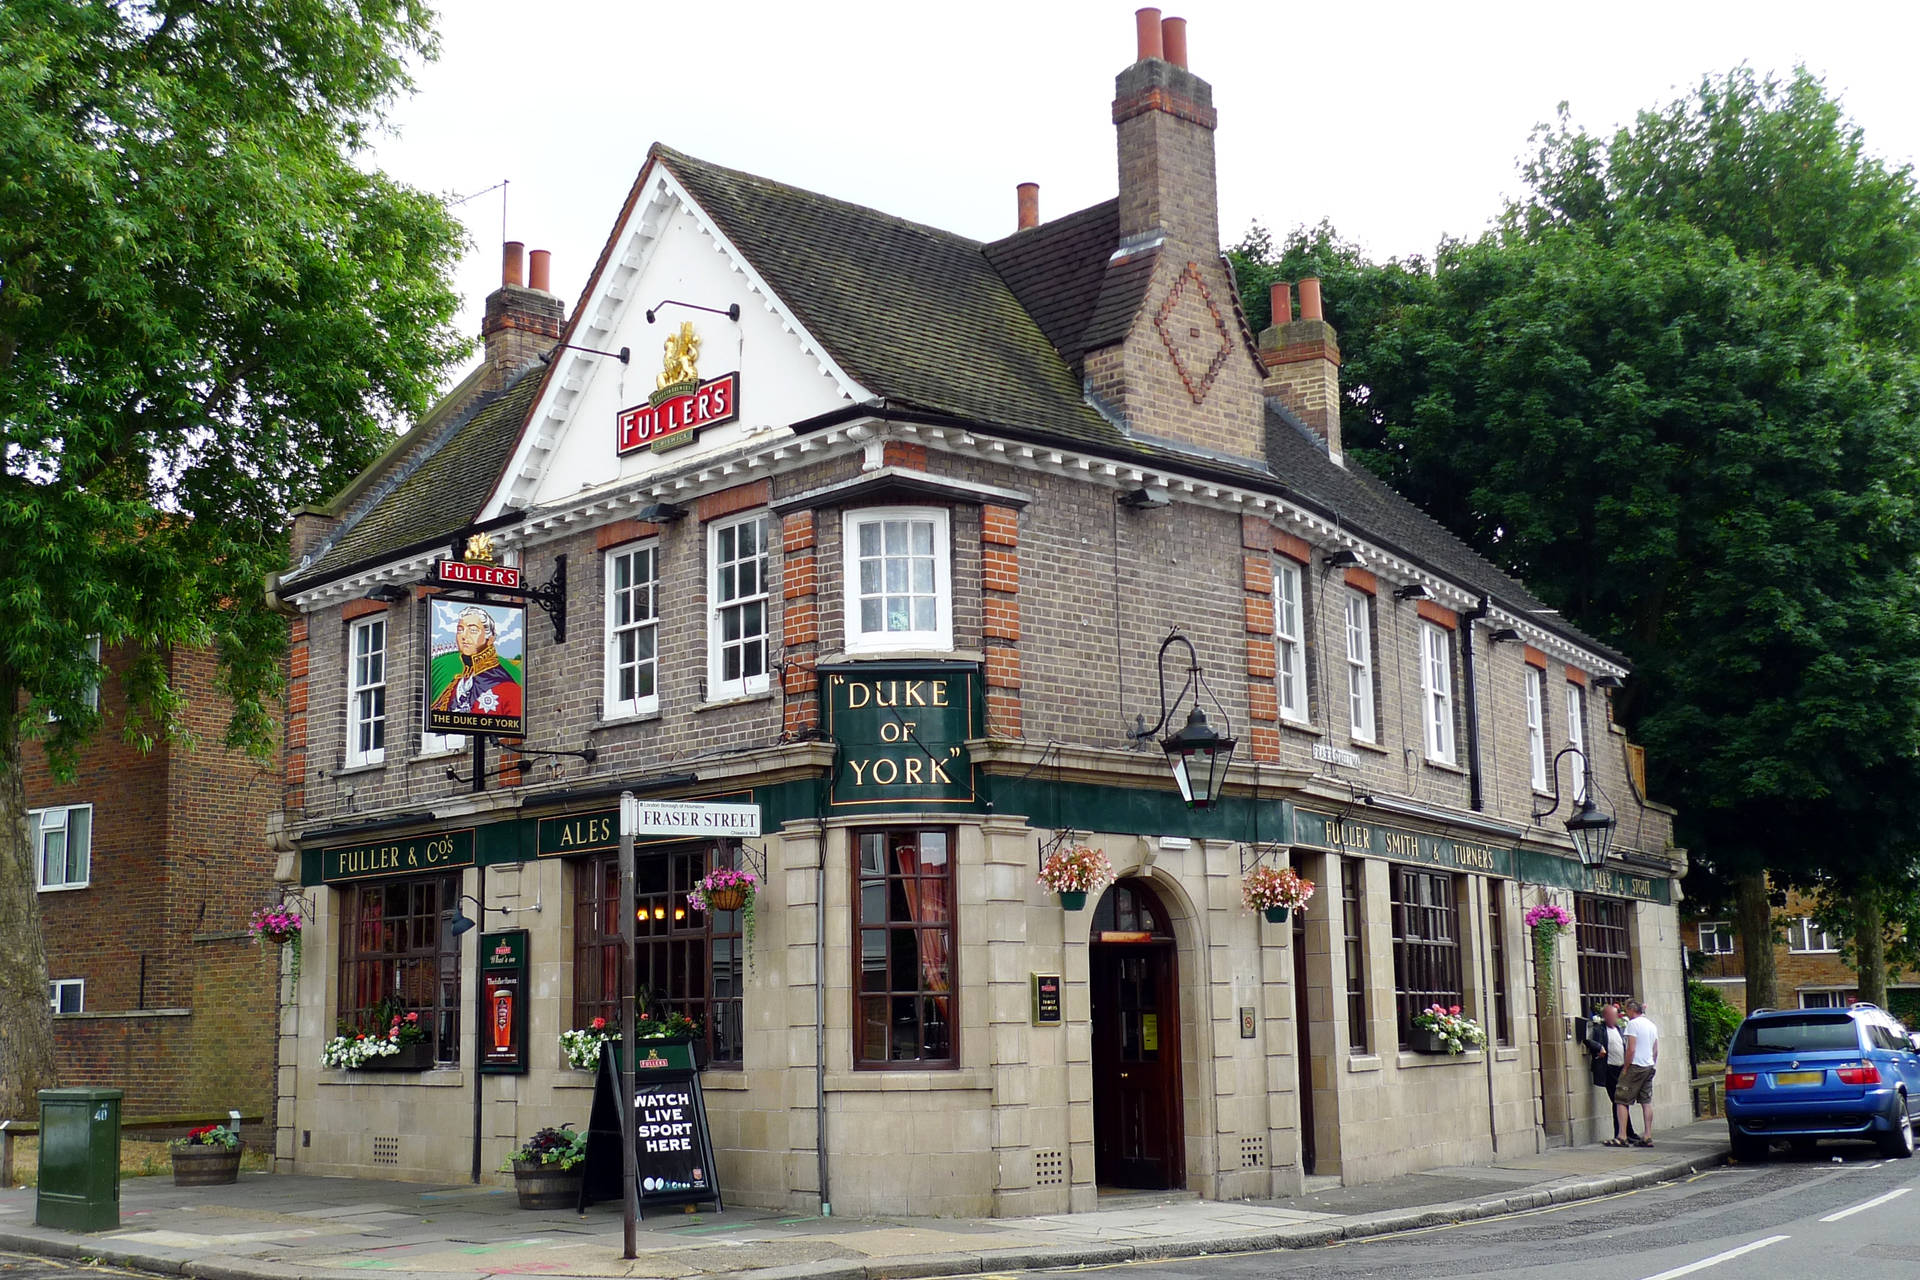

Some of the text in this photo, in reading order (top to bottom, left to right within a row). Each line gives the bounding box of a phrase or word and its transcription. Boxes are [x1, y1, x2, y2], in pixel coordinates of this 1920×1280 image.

[623, 386, 726, 444] FULLER'S
[445, 562, 515, 585] FULLER'S
[432, 714, 520, 729] THE DUKE OF YORK
[880, 722, 916, 742] OF
[643, 810, 757, 828] FRASER STREET
[560, 818, 610, 847] ALES
[1325, 820, 1494, 869] FULLER SMITH & TURNER'S
[340, 846, 399, 873] FULLER
[408, 846, 418, 867] &
[634, 1093, 689, 1108] WATCH
[644, 1108, 683, 1122] LIVE
[638, 1123, 692, 1138] SPORT
[646, 1138, 692, 1153] HERE
